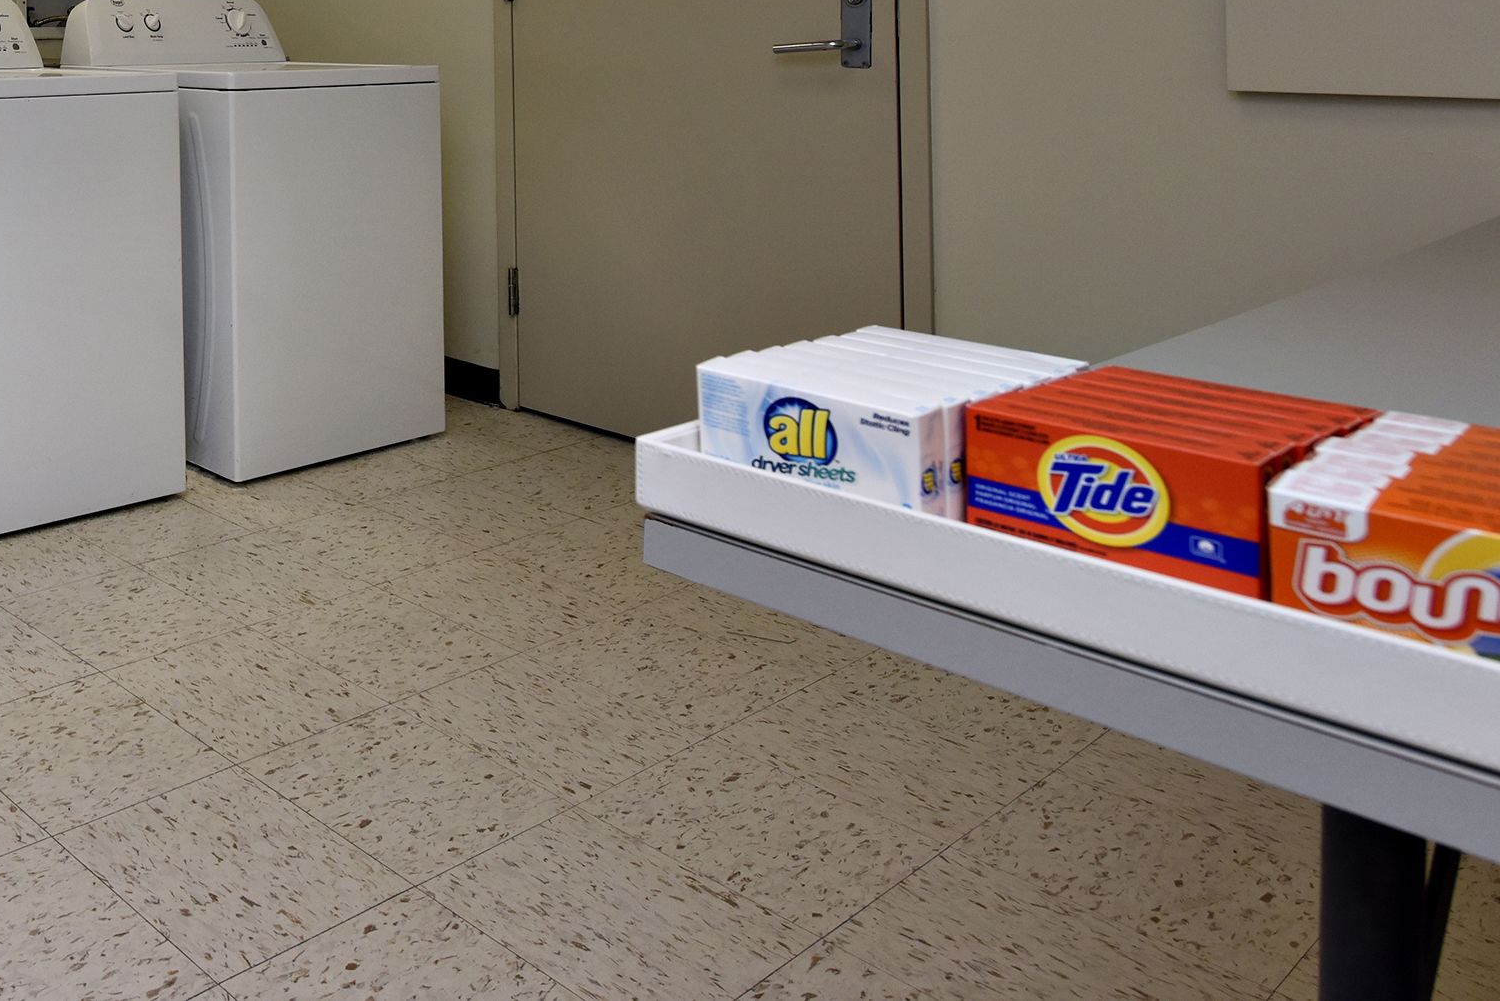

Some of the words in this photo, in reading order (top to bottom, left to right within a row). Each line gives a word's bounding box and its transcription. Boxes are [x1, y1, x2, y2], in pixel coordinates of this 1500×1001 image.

[860, 417, 885, 429] Static
[886, 424, 911, 437] Cling
[873, 412, 910, 426] Reduces
[768, 408, 832, 460] all
[797, 461, 857, 483] sheets
[1050, 461, 1157, 517] Tide
